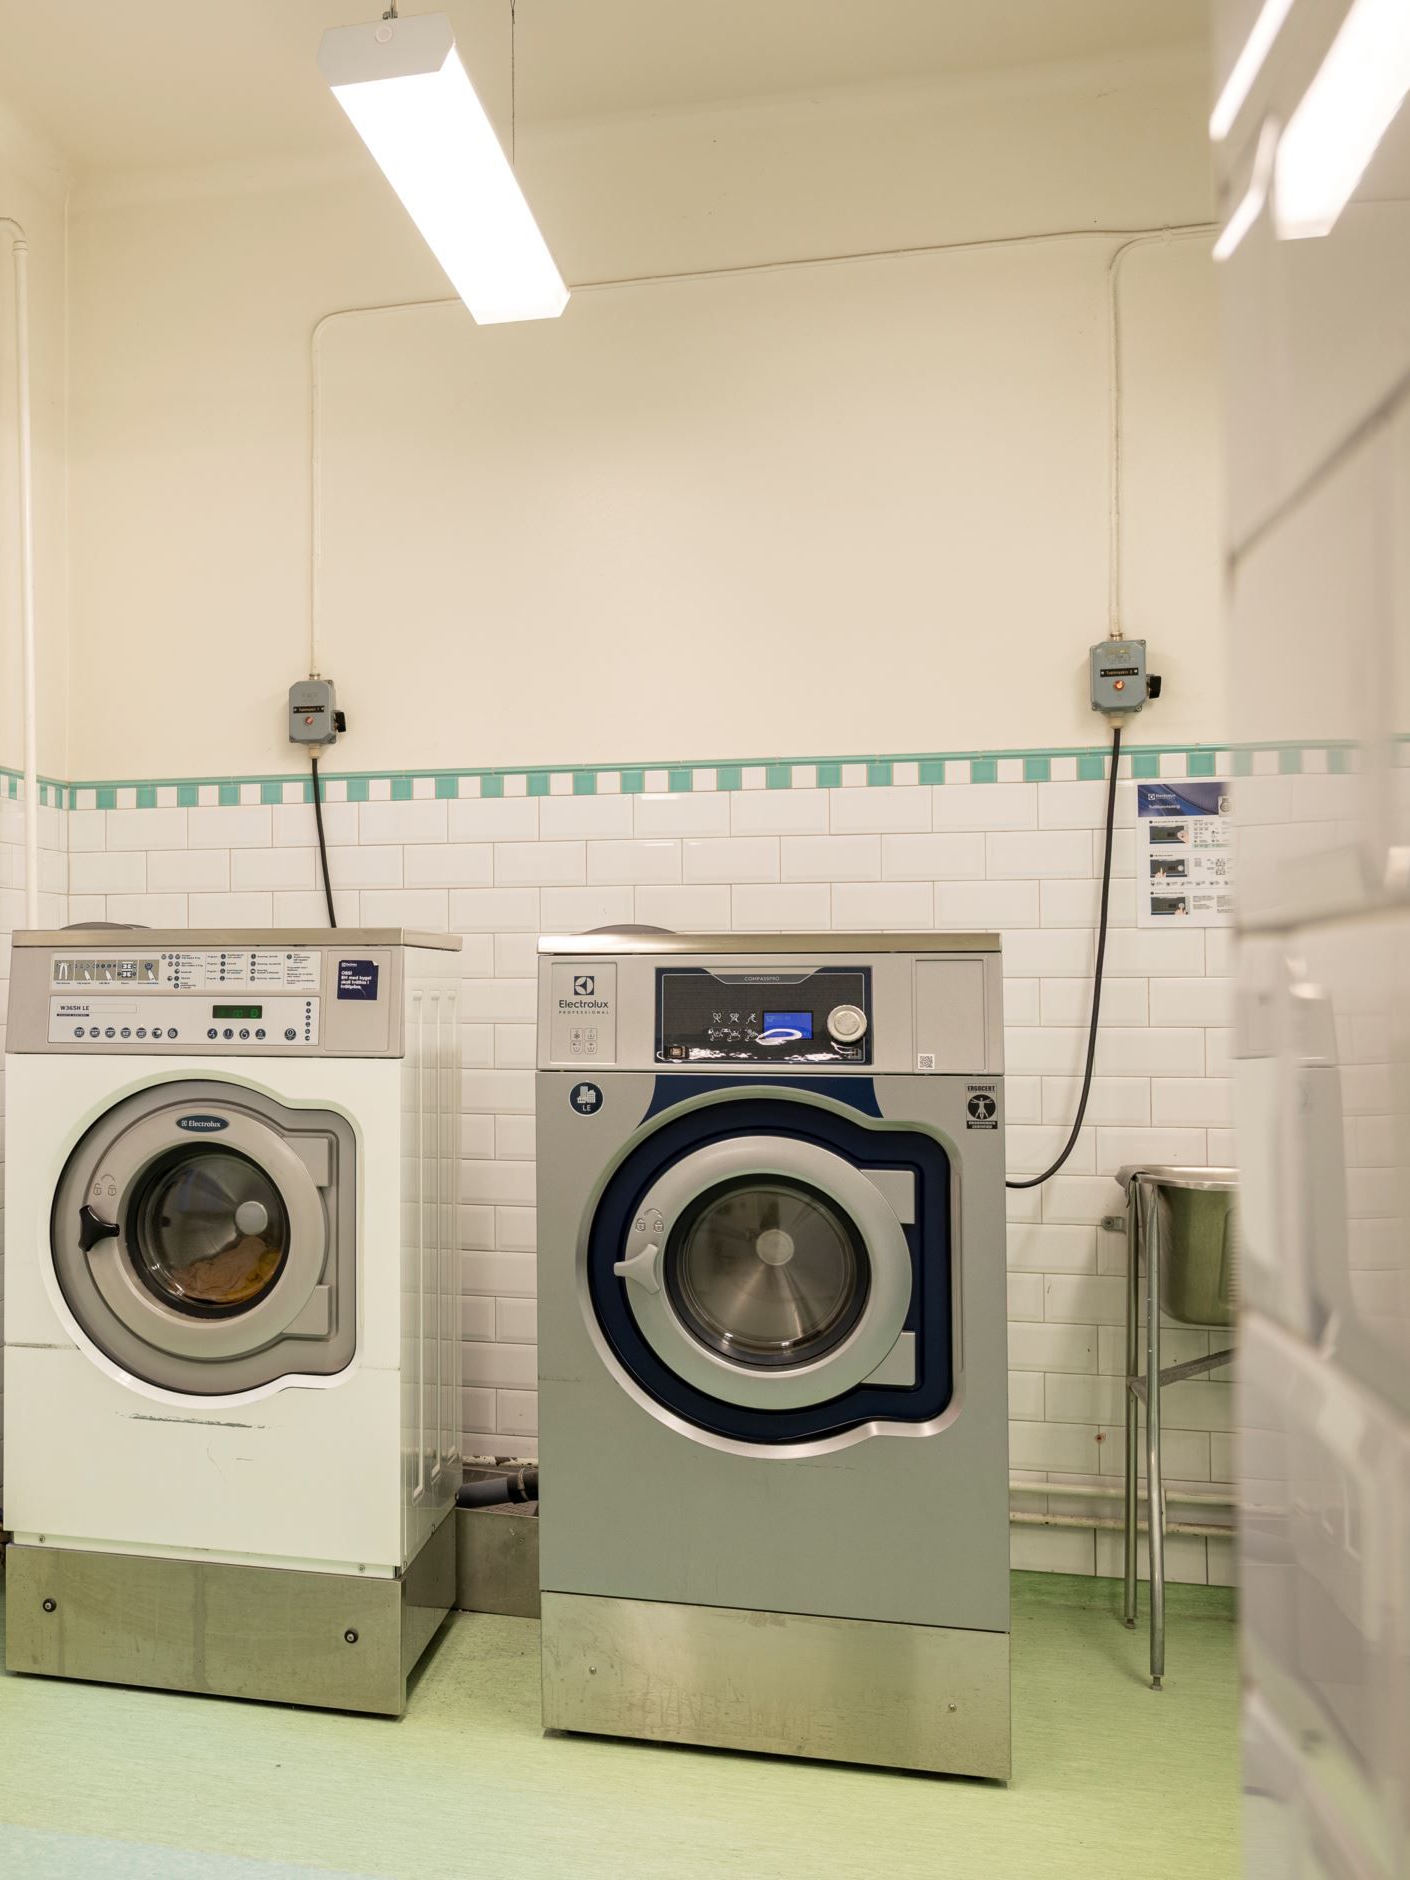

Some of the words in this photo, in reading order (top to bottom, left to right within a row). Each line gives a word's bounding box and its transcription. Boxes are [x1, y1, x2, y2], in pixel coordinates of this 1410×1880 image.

[558, 999, 609, 1009] Electrolux
[582, 1104, 591, 1112] LE
[188, 1120, 221, 1128] Electrolux
